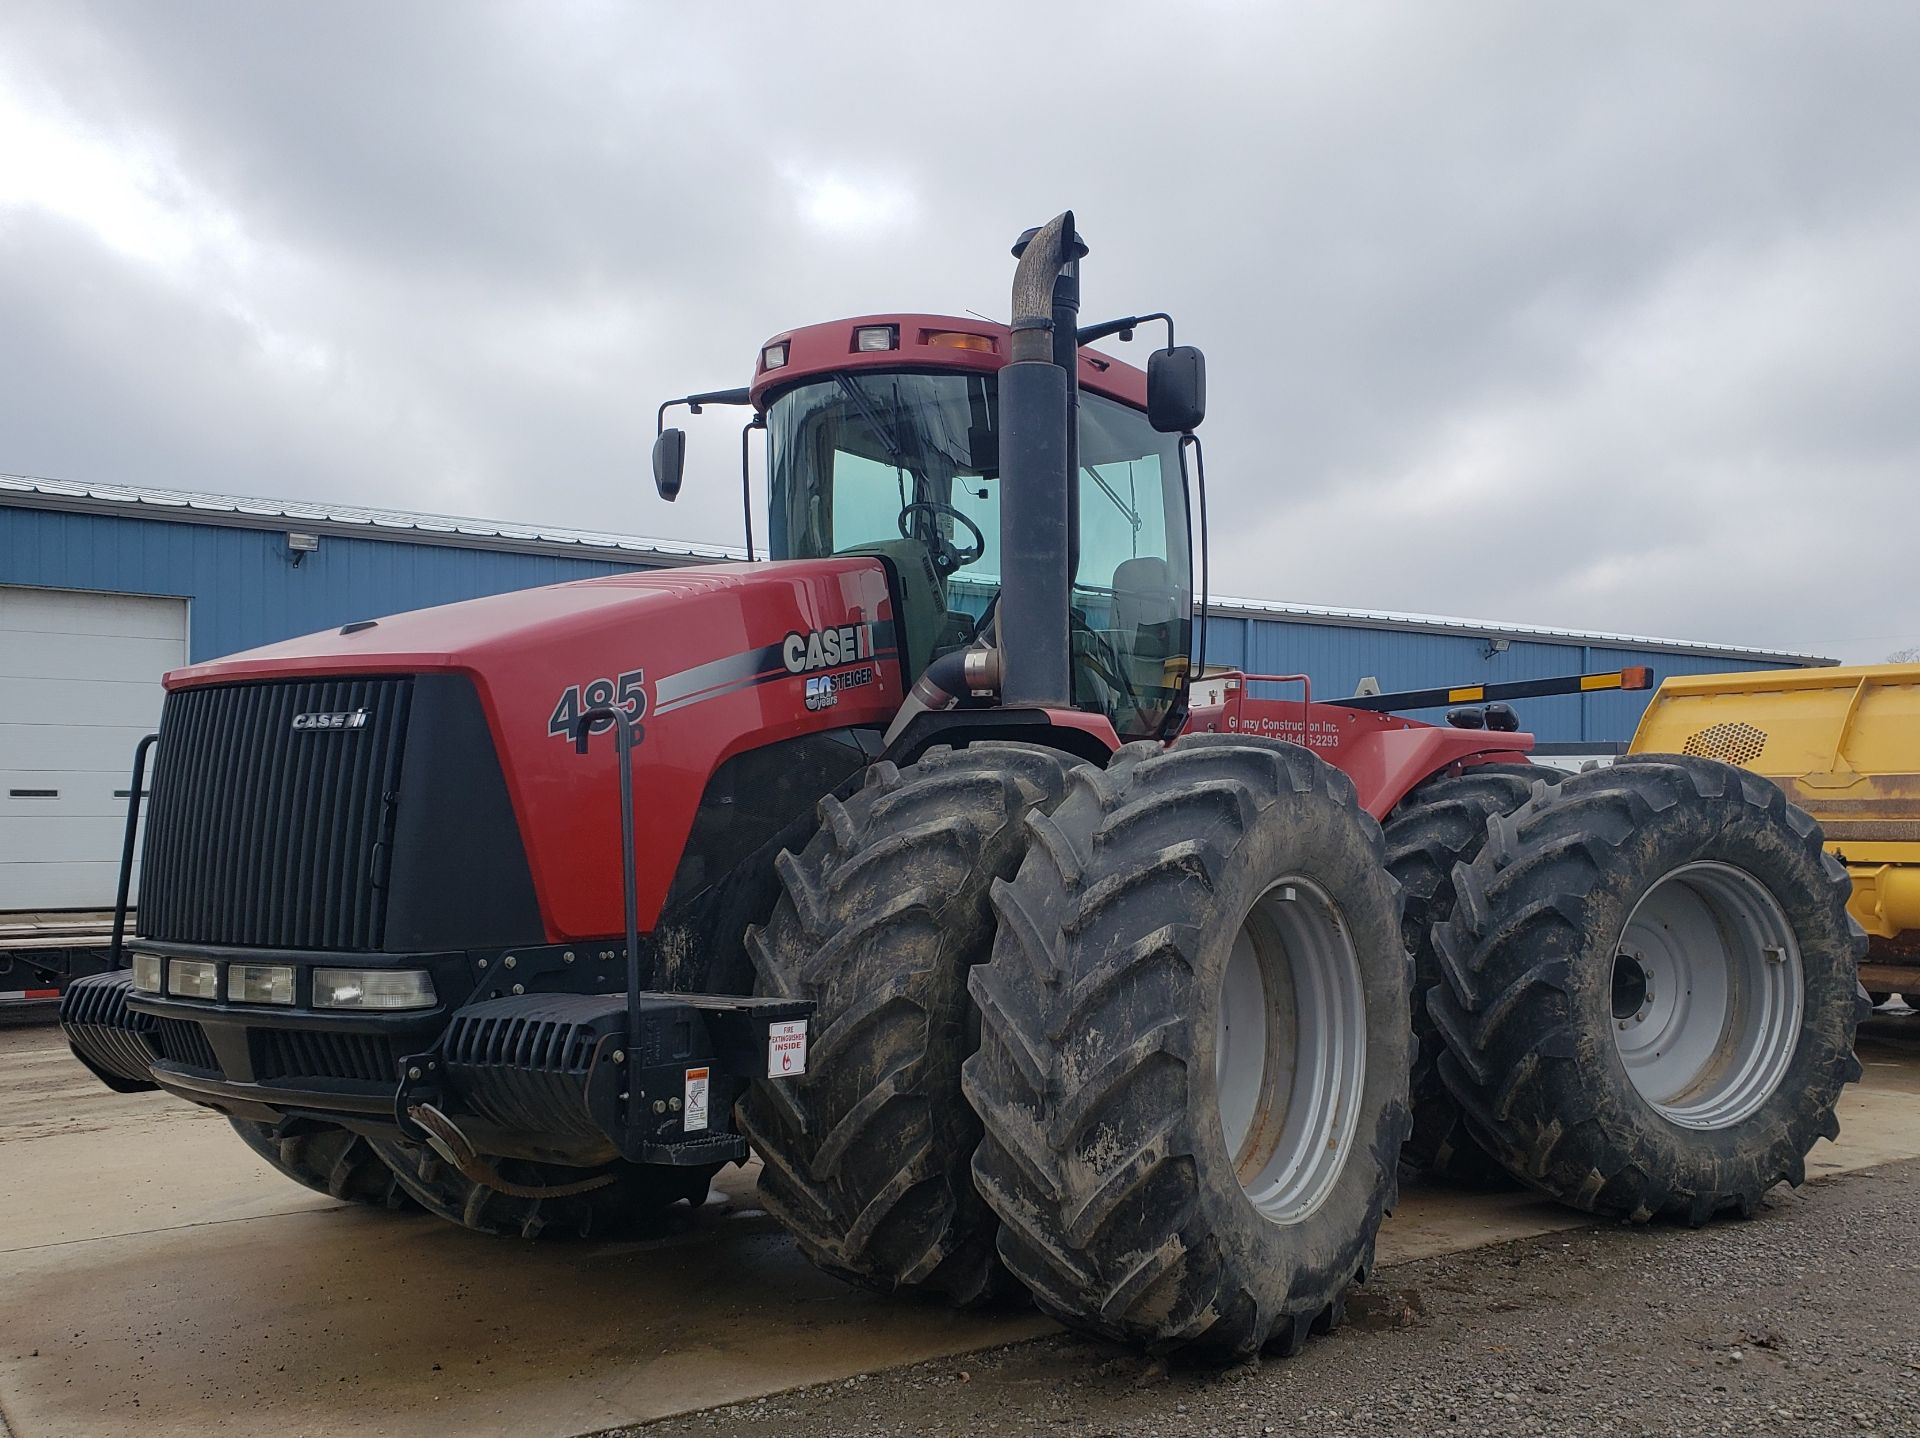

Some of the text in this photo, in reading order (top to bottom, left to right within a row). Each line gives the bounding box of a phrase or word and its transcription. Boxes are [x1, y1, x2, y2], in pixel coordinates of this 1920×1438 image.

[805, 667, 873, 711] 50 STEIGER
[547, 667, 648, 743] 485
[817, 695, 838, 711] years
[1262, 718, 1320, 731] Constructon
[1322, 720, 1339, 732] Inc.
[783, 1026, 794, 1034] FIRE
[775, 1041, 802, 1052] INSIDE
